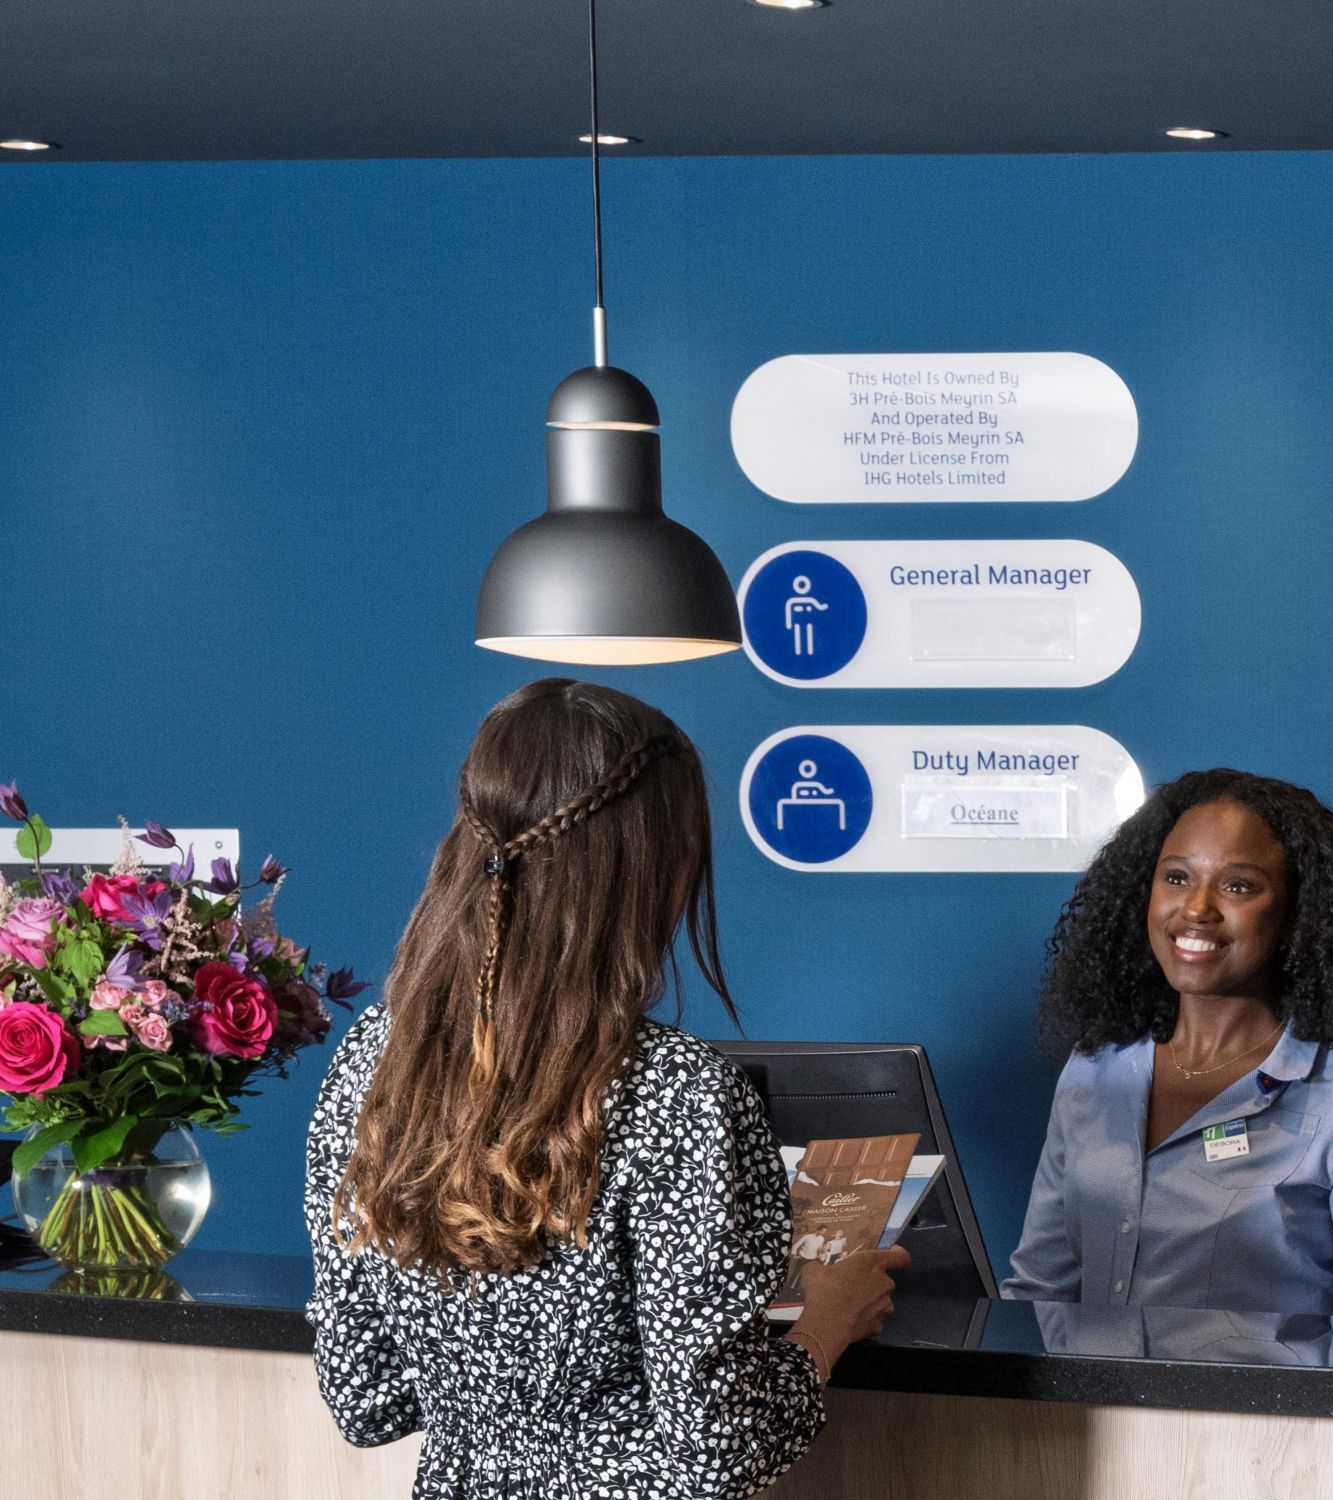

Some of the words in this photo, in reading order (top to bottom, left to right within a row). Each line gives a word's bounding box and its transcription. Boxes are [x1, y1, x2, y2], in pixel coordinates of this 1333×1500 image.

[847, 371, 877, 386] This
[882, 371, 921, 386] Hotel
[927, 371, 939, 386] Is
[944, 371, 995, 386] Owned
[1000, 371, 1020, 389] By
[849, 391, 869, 406] 3H
[874, 390, 936, 406] Pré-Bois
[941, 391, 994, 410] Meyrin
[998, 391, 1018, 406] SA
[871, 411, 900, 426] And
[905, 411, 973, 429] Operated
[978, 411, 998, 429] By
[844, 431, 876, 446] HFM
[881, 430, 943, 446] Pré-Bois
[948, 431, 1001, 449] Meyrin
[1005, 431, 1025, 446] SA
[860, 450, 904, 466] Under
[909, 450, 966, 466] License
[971, 450, 1009, 466] From
[865, 470, 892, 486] IHG
[897, 470, 944, 486] Hotels
[948, 470, 1006, 486] Limited
[890, 564, 980, 587] General
[988, 565, 1092, 590] Manager
[913, 750, 969, 776] Duty
[977, 750, 1080, 776] Manager
[950, 804, 1019, 822] Océane
[1210, 1139, 1241, 1148] DEBORA
[806, 1207, 838, 1215] MAISON
[839, 1205, 867, 1213] CAILLER
